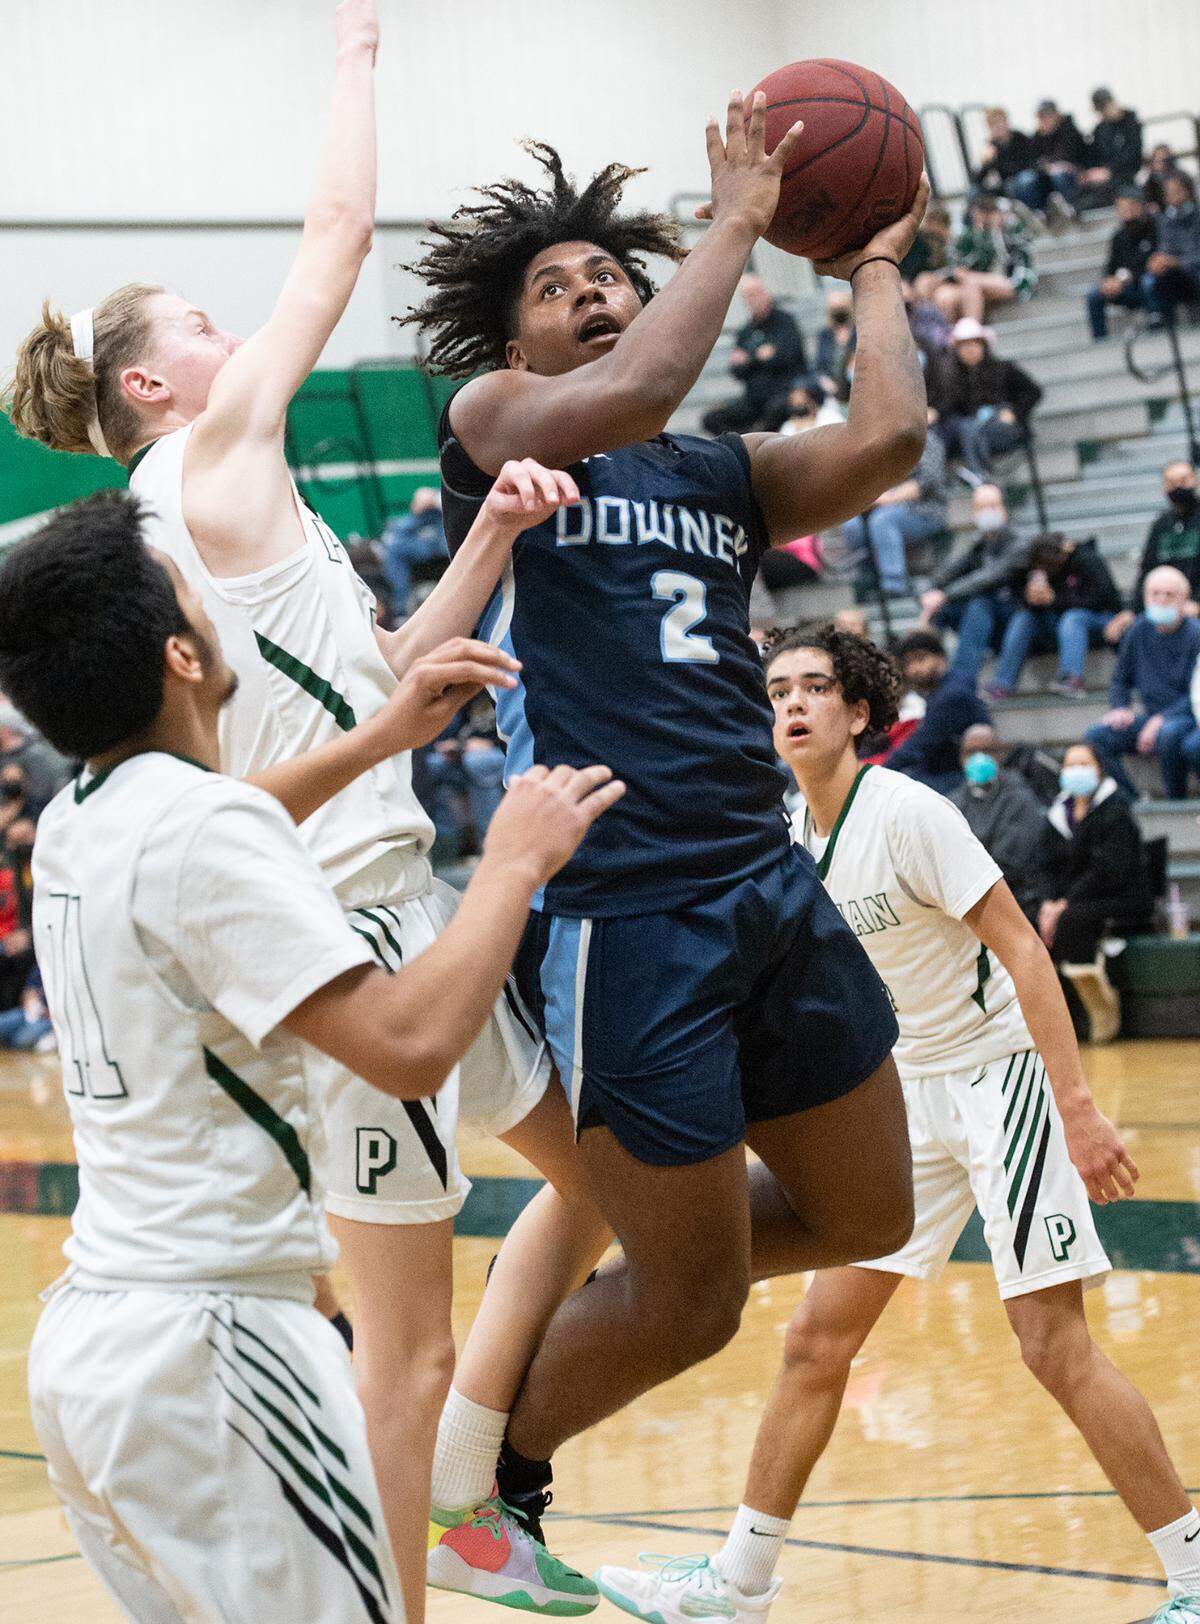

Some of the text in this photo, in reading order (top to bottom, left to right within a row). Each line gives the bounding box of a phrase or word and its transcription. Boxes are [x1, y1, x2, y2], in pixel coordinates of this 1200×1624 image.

[651, 568, 720, 664] 2
[356, 1127, 397, 1195] P
[1044, 1214, 1076, 1262] P
